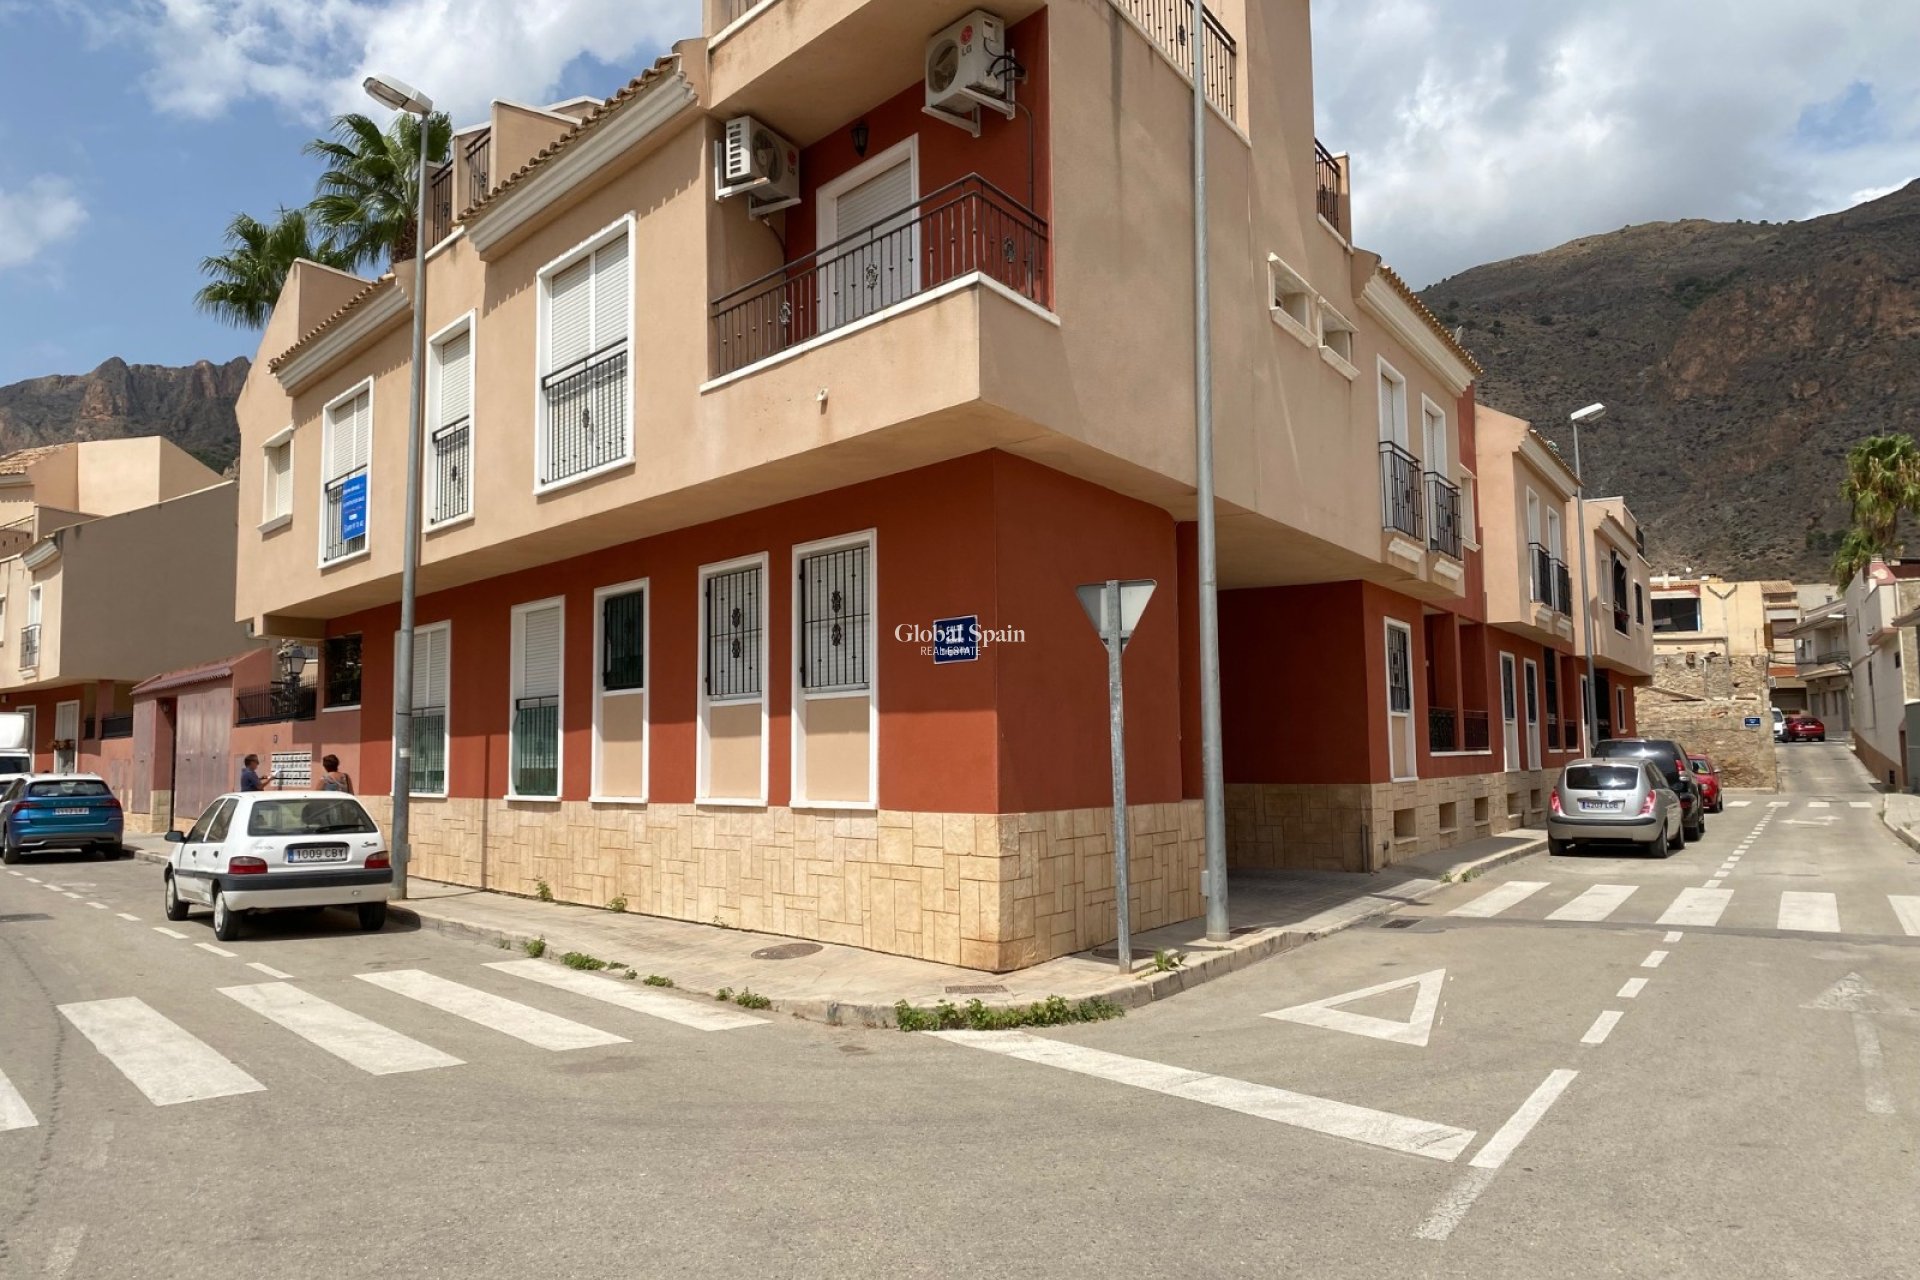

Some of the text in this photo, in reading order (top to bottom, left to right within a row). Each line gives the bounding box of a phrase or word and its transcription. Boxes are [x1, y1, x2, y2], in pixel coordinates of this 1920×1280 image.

[961, 45, 973, 56] LG
[297, 848, 344, 859] 1009 CBY
